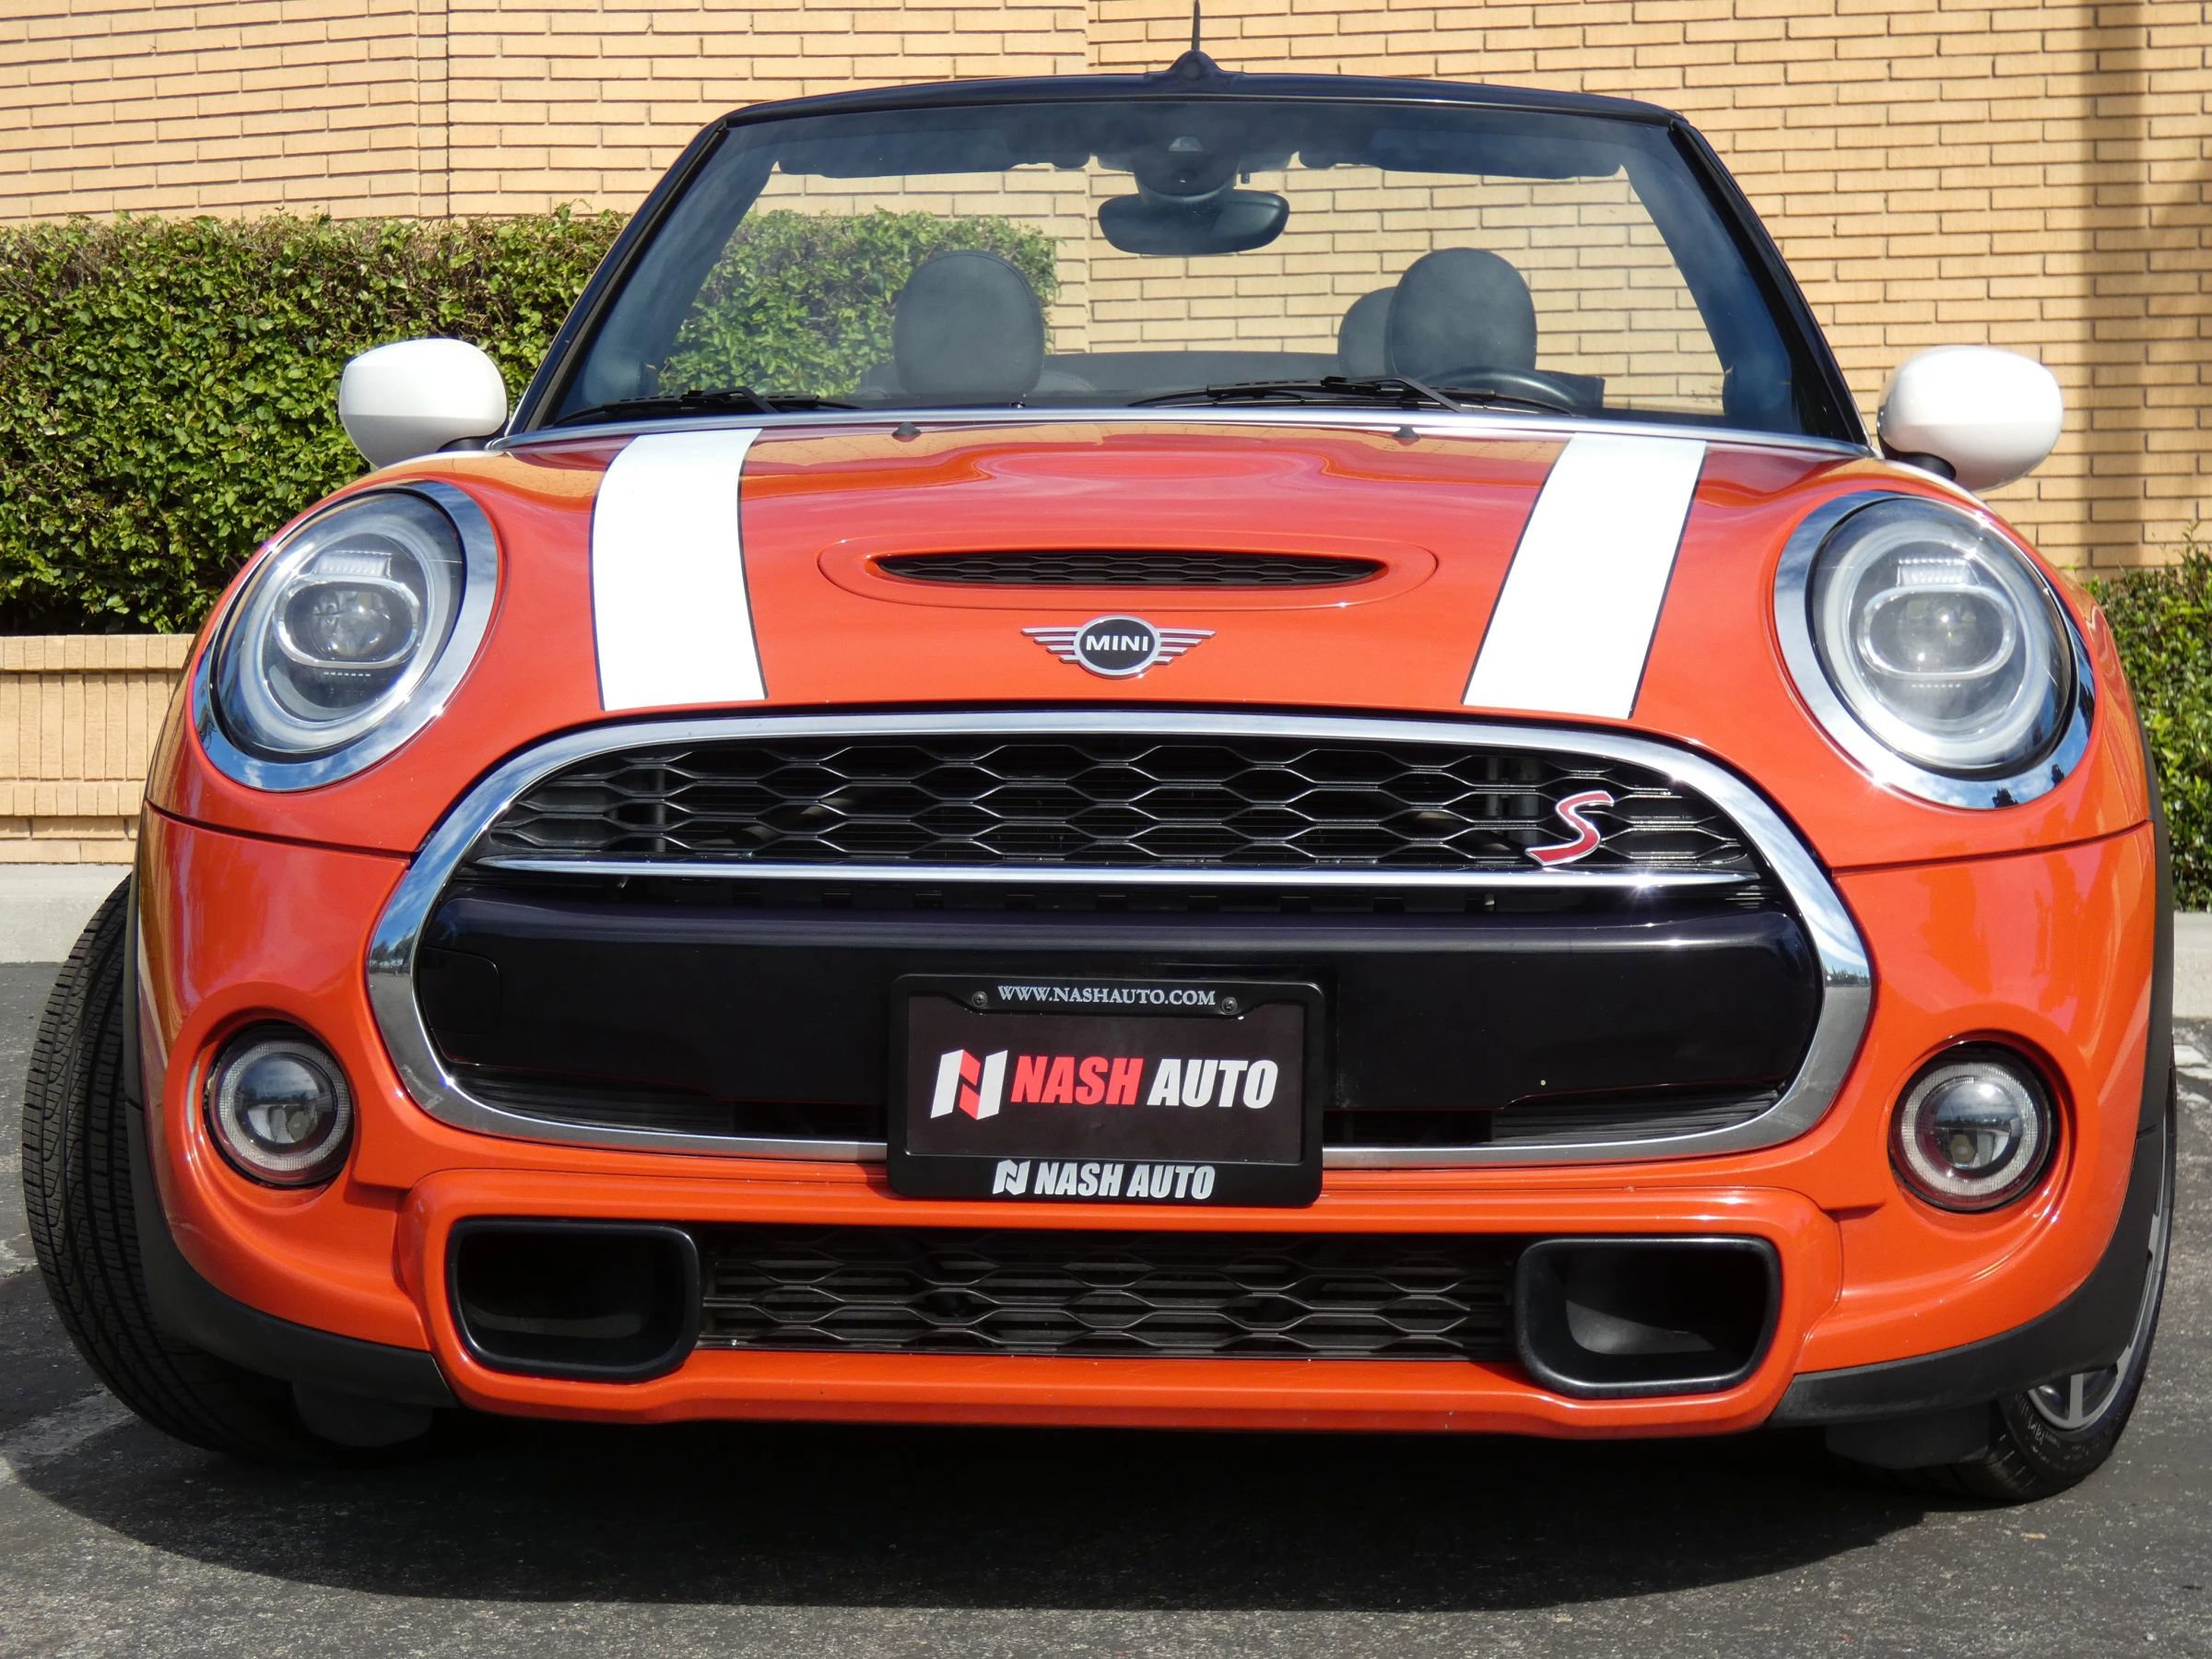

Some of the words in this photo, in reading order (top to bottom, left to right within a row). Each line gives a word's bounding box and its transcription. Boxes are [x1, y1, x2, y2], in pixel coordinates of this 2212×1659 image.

[1086, 635, 1148, 652] MINI
[1524, 790, 1615, 866] S
[997, 985, 1217, 1006] WWW.NASHAUTO.COM
[1010, 1055, 1145, 1105] NASH
[1147, 1058, 1278, 1109] AUTO
[1034, 1162, 1124, 1196] NASH
[1127, 1165, 1216, 1199] AUTO
